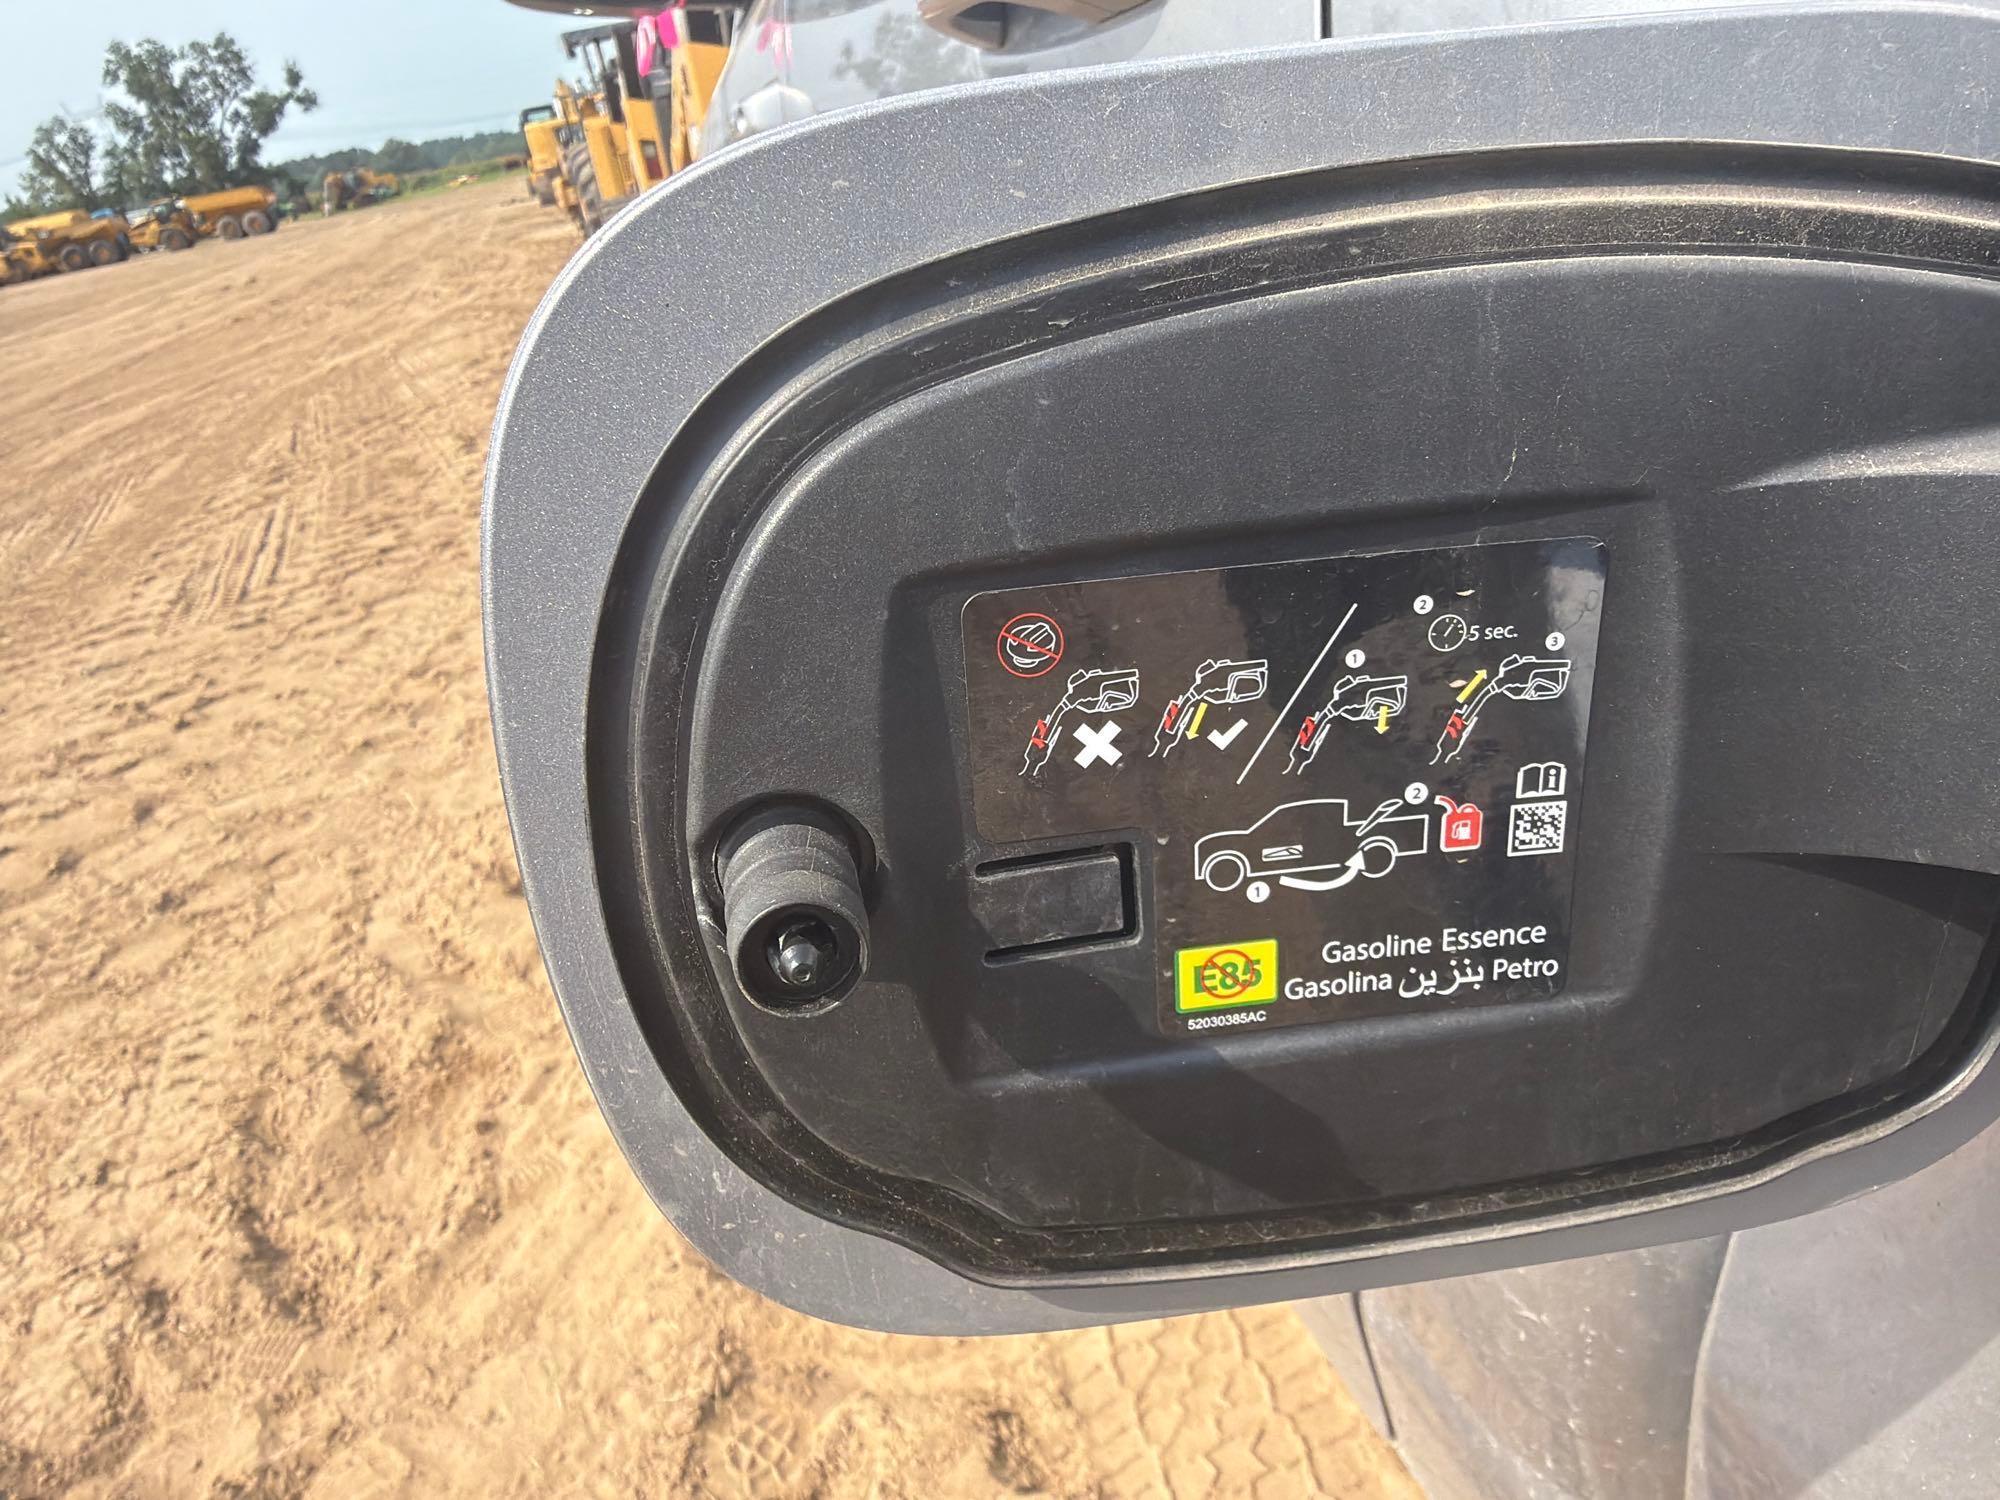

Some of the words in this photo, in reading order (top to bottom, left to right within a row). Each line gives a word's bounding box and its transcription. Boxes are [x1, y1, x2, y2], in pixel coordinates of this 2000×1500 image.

[1468, 625, 1480, 641] 5
[1484, 625, 1519, 640] sec.
[1322, 934, 1432, 964] Gasoline
[1442, 925, 1547, 952] Essence
[1194, 958, 1262, 994] E85
[1284, 971, 1393, 1000] Gasolina
[1398, 958, 1485, 999] بنزين
[1492, 957, 1559, 981] Petro
[1187, 1010, 1267, 1031] 52030385AC
